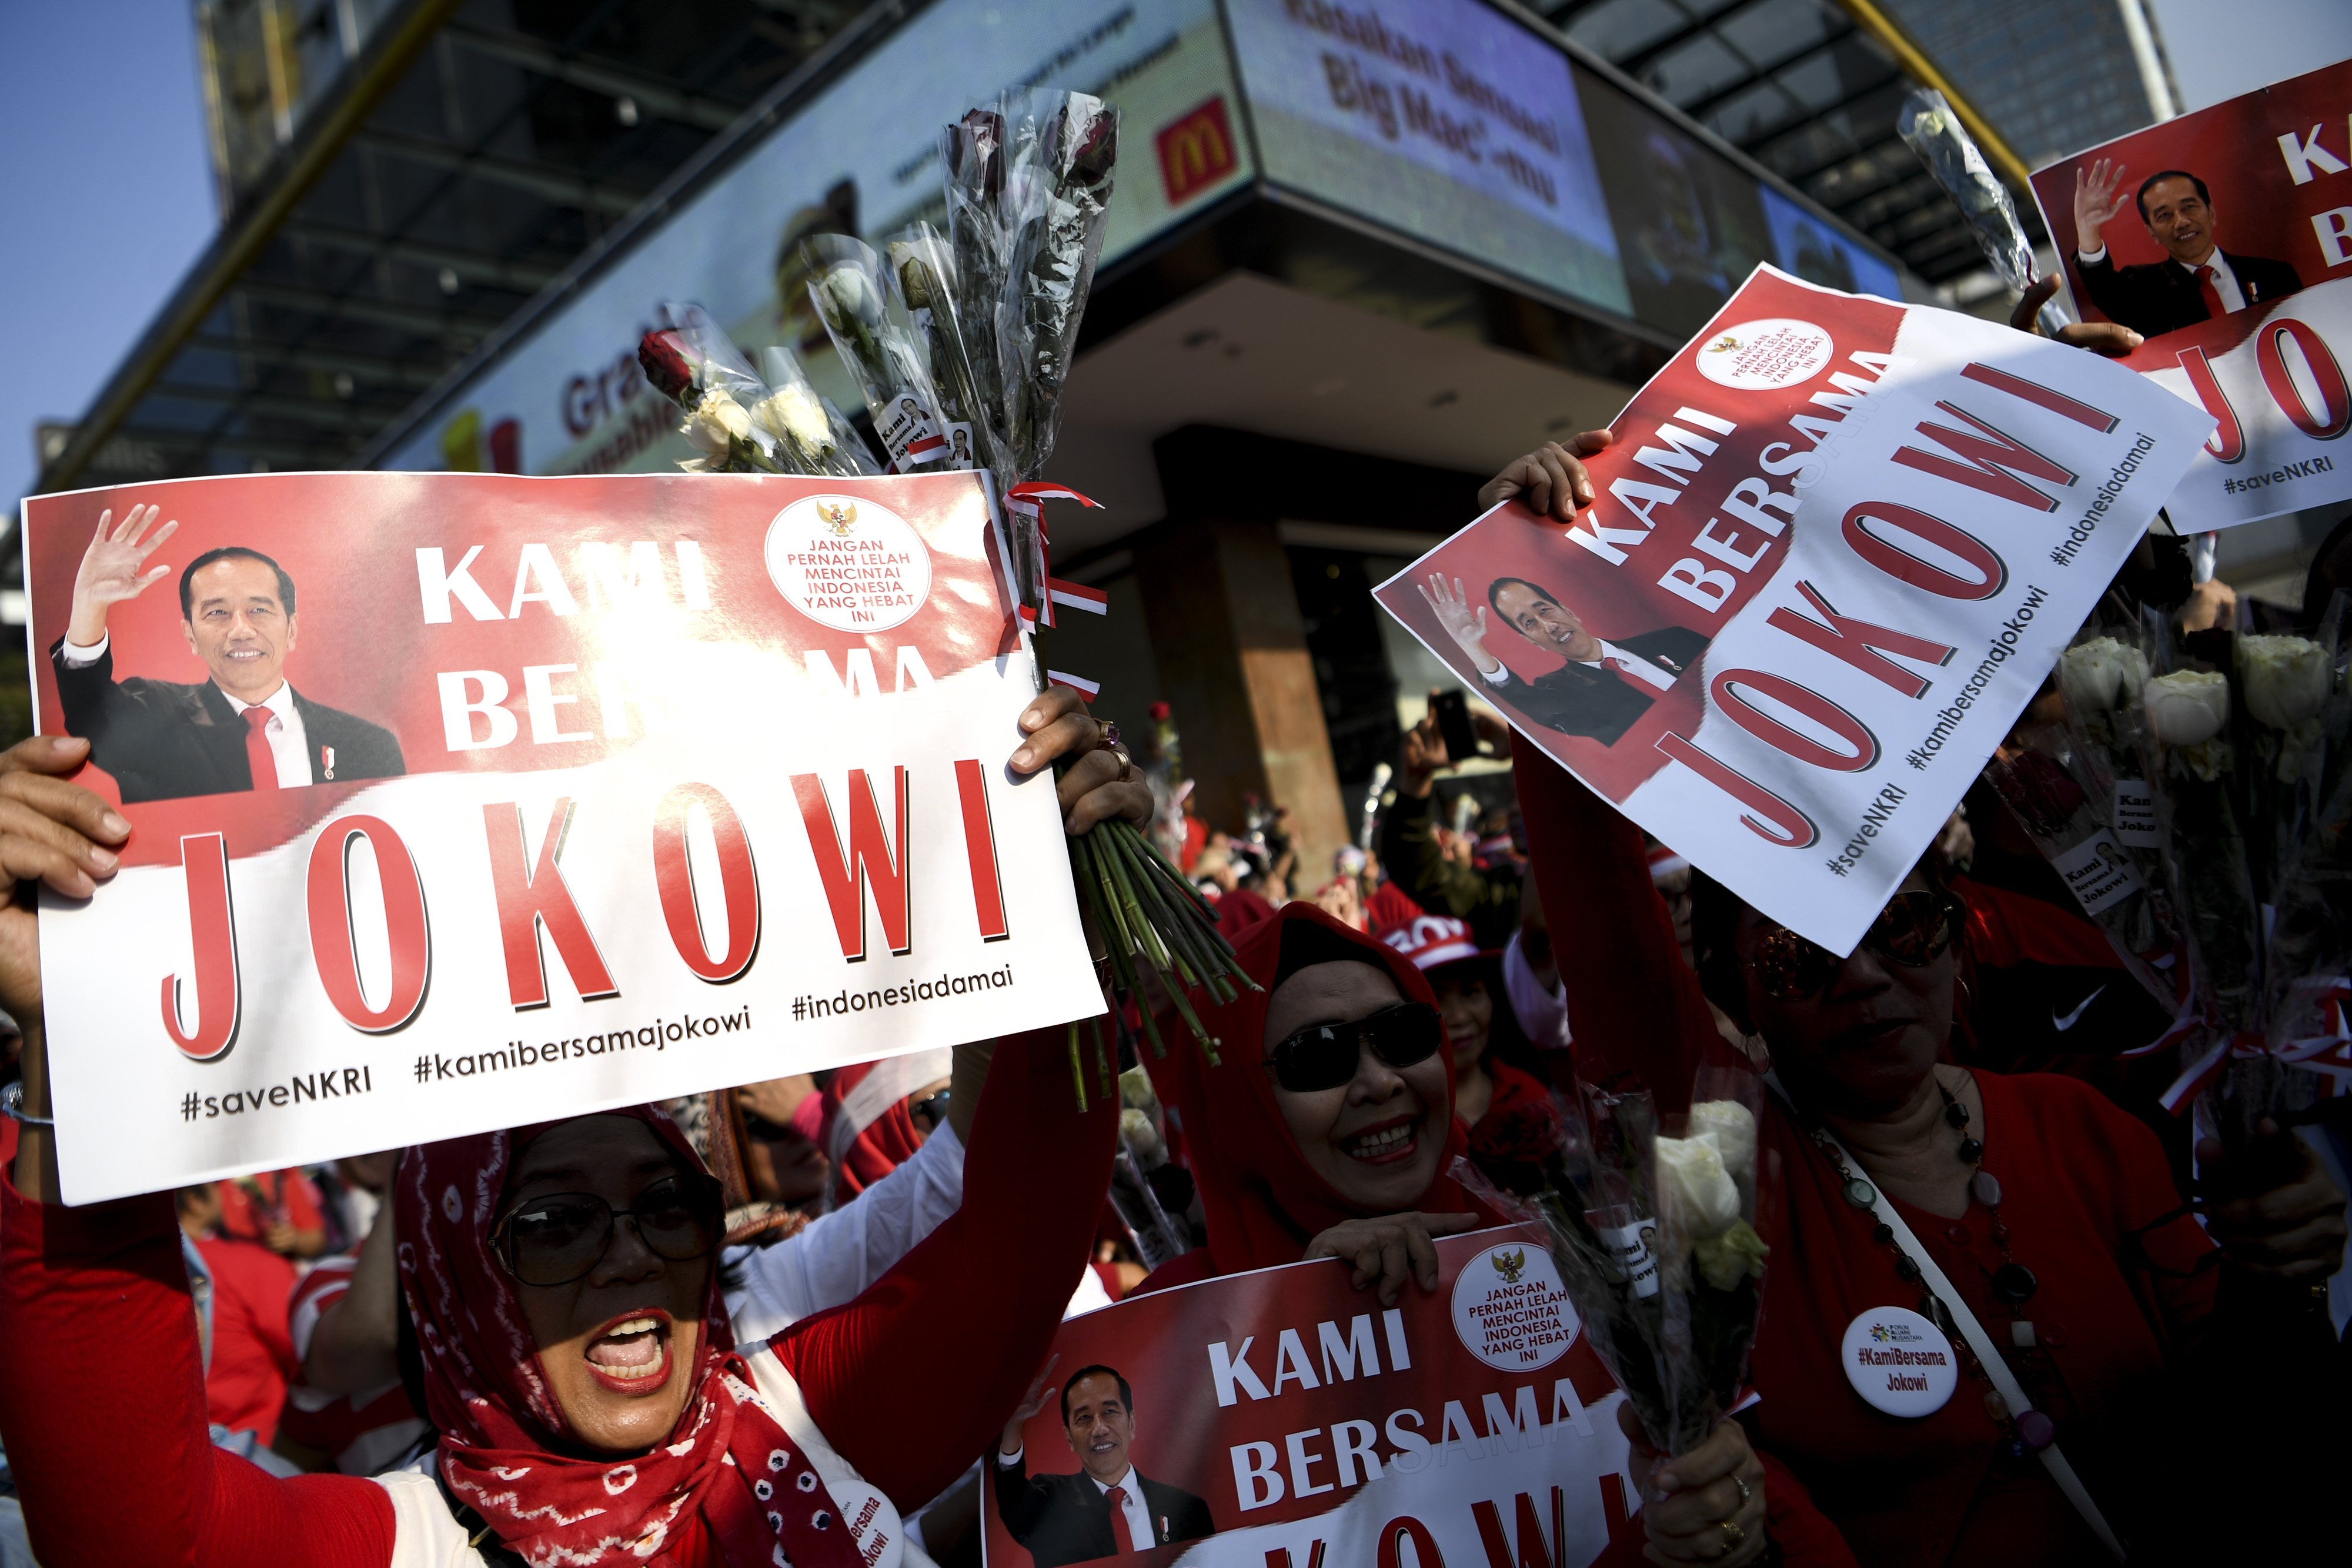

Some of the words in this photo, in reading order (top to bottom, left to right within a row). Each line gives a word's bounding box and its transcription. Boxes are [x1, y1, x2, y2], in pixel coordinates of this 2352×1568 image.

[1321, 50, 1399, 141] Big
[1732, 335, 1770, 365] JANGAN
[1732, 349, 1765, 377] PERNAH
[1768, 327, 1792, 347] LELAH
[1750, 335, 1798, 375] MENCINTAI
[1761, 337, 1810, 377] INDONESIA
[1770, 361, 1799, 383] YANG
[1796, 336, 1824, 359] HEBAT
[1801, 358, 1818, 369] INI
[882, 413, 906, 442] Kami
[888, 425, 911, 451] Bersama
[1564, 406, 1738, 566] KAMI
[1656, 350, 1919, 614] BERSAMA
[2224, 456, 2334, 494] #saveNKRI
[787, 554, 856, 565] PERNAH
[861, 553, 910, 565] LELAH
[809, 540, 884, 551] JANGAN
[415, 540, 712, 624] KAMI
[806, 567, 900, 579] MENCINTAI
[808, 581, 904, 594] INDONESIA
[804, 597, 856, 608] YANG
[862, 594, 913, 607] HEBAT
[1653, 362, 2121, 849] JOKOWI
[851, 611, 874, 621] INI
[1826, 783, 1908, 877] #saveNKRI
[1905, 584, 2049, 772] #kamibersamajokowi
[2049, 432, 2156, 567] #indonesiadamai
[2066, 858, 2103, 882] Kami
[2075, 871, 2109, 892] Bersama
[2083, 872, 2129, 904] Jokowi
[161, 758, 1010, 1063] JOKOWI
[181, 1065, 373, 1123] #saveNKRI
[414, 1004, 751, 1084] #kamibersamajokowi
[791, 963, 1014, 1022] #indonesiadamai
[1469, 1298, 1524, 1318] PERNAH
[1528, 1290, 1568, 1307] LELAH
[1486, 1281, 1546, 1302] JANGAN
[1483, 1305, 1559, 1329] MENCINTAI
[1485, 1318, 1562, 1342] INDONESIA
[1482, 1339, 1524, 1356] YANG
[1528, 1329, 1569, 1347] HEBAT
[1519, 1349, 1538, 1362] INI
[1859, 1348, 1946, 1366] #KamiBersama
[1207, 1308, 1411, 1408] KAMI
[1887, 1373, 1929, 1392] Jokowi
[1230, 1377, 1596, 1512] BERSAMA
[847, 1497, 881, 1544] ersama
